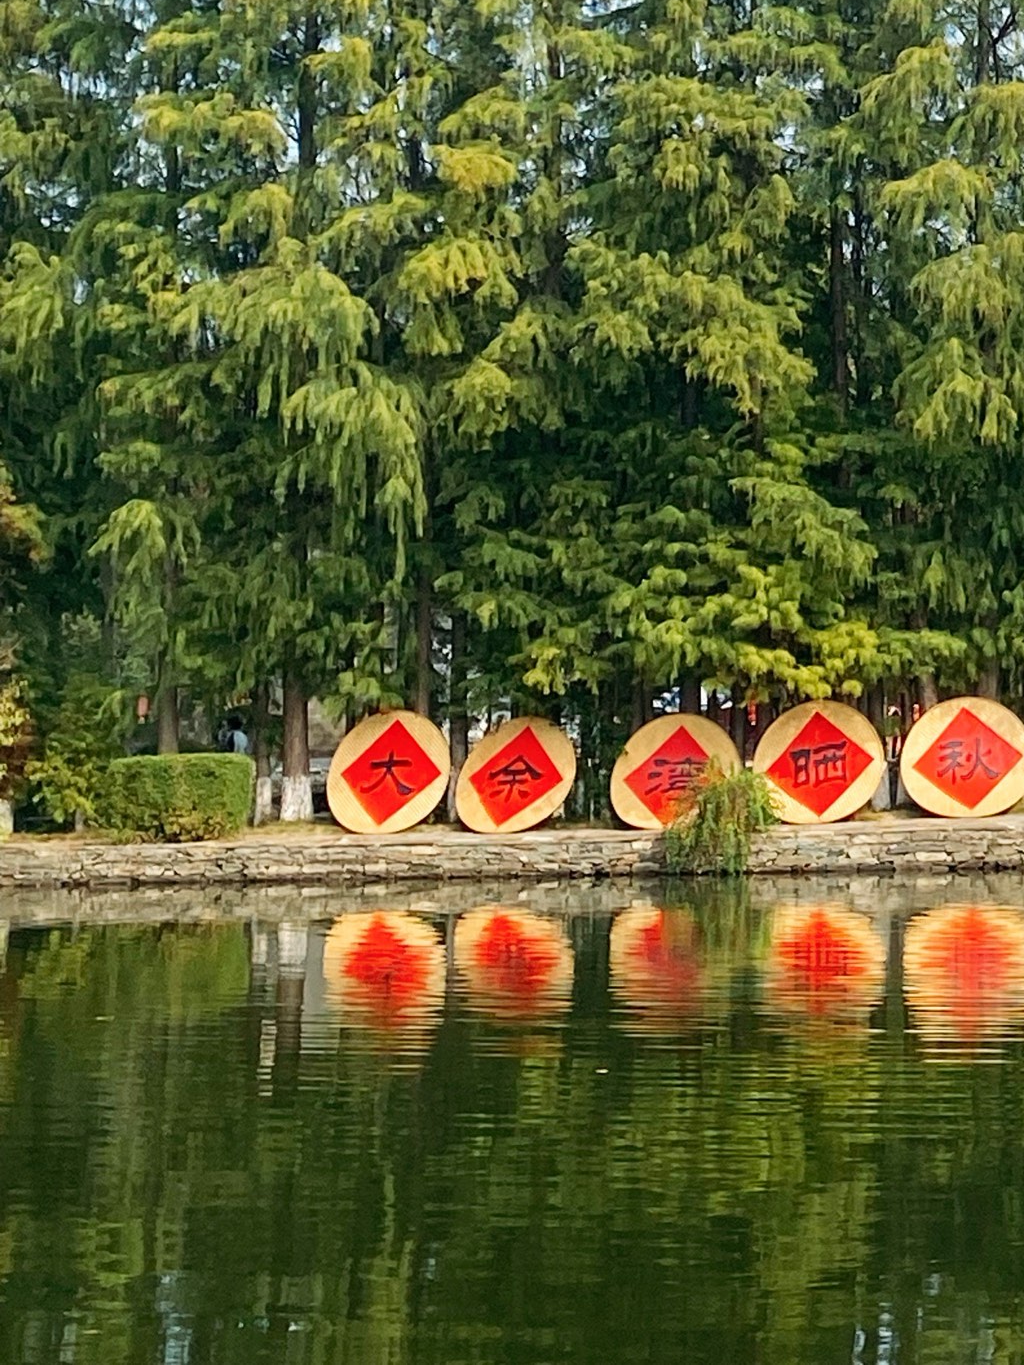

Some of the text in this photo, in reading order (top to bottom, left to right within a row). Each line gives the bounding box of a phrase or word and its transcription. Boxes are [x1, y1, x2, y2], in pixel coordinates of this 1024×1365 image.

[359, 750, 415, 795] 大
[488, 754, 543, 803] 余
[787, 739, 848, 788] 晒
[936, 737, 1001, 785] 秋
